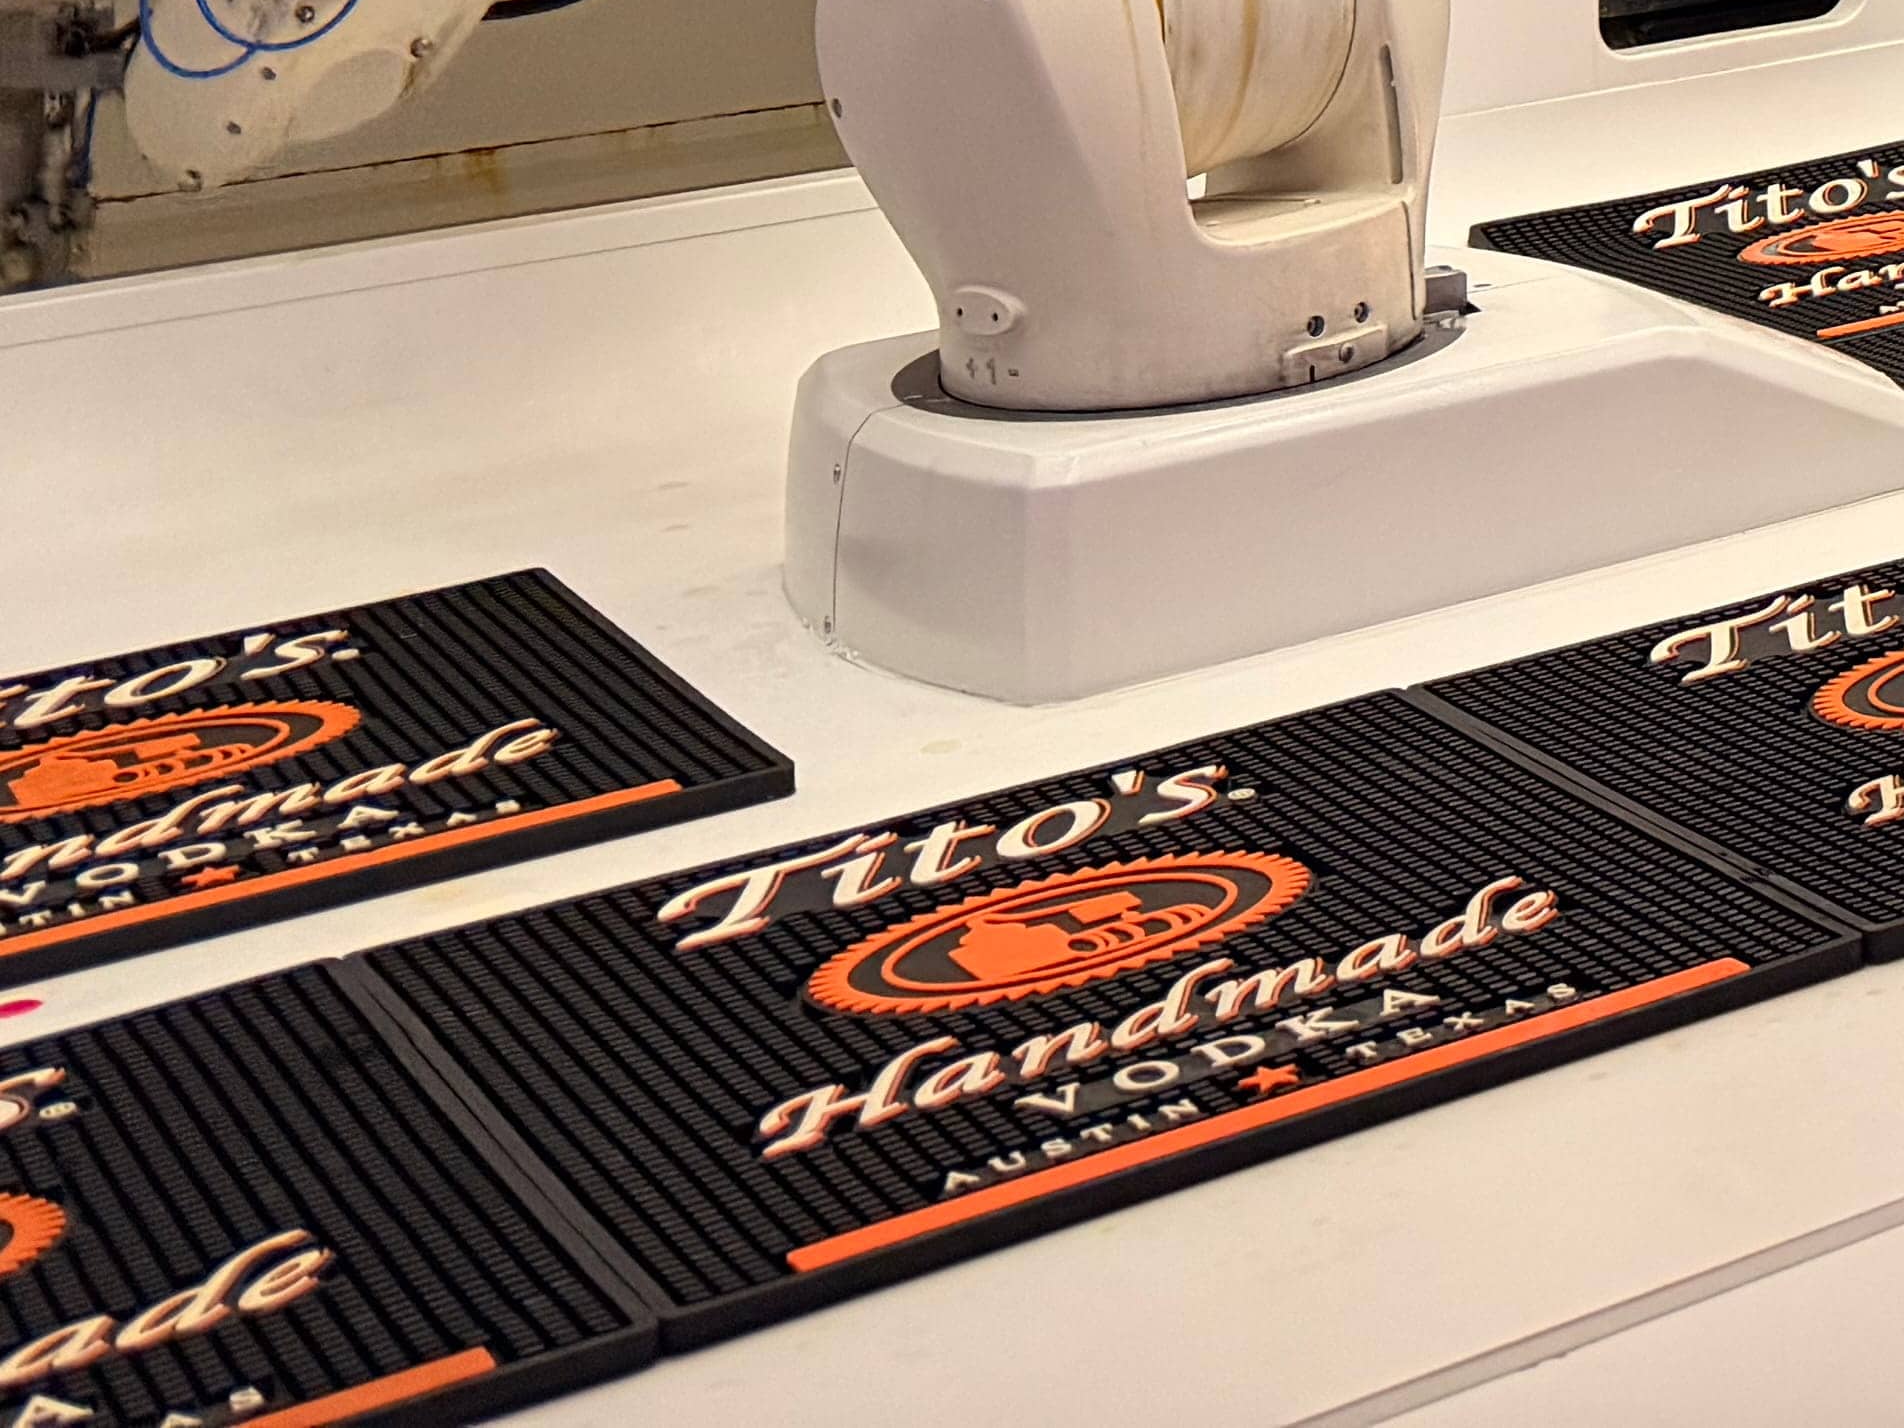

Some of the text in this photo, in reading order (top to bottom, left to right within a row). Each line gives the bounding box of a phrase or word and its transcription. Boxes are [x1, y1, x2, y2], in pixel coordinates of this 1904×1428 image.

[0, 717, 558, 879] ndmade
[287, 799, 522, 863] TEXAS
[759, 874, 1558, 1158] Handmade
[940, 981, 1578, 1192] AUSTIN TEXAS
[1012, 983, 1439, 1117] VODKA
